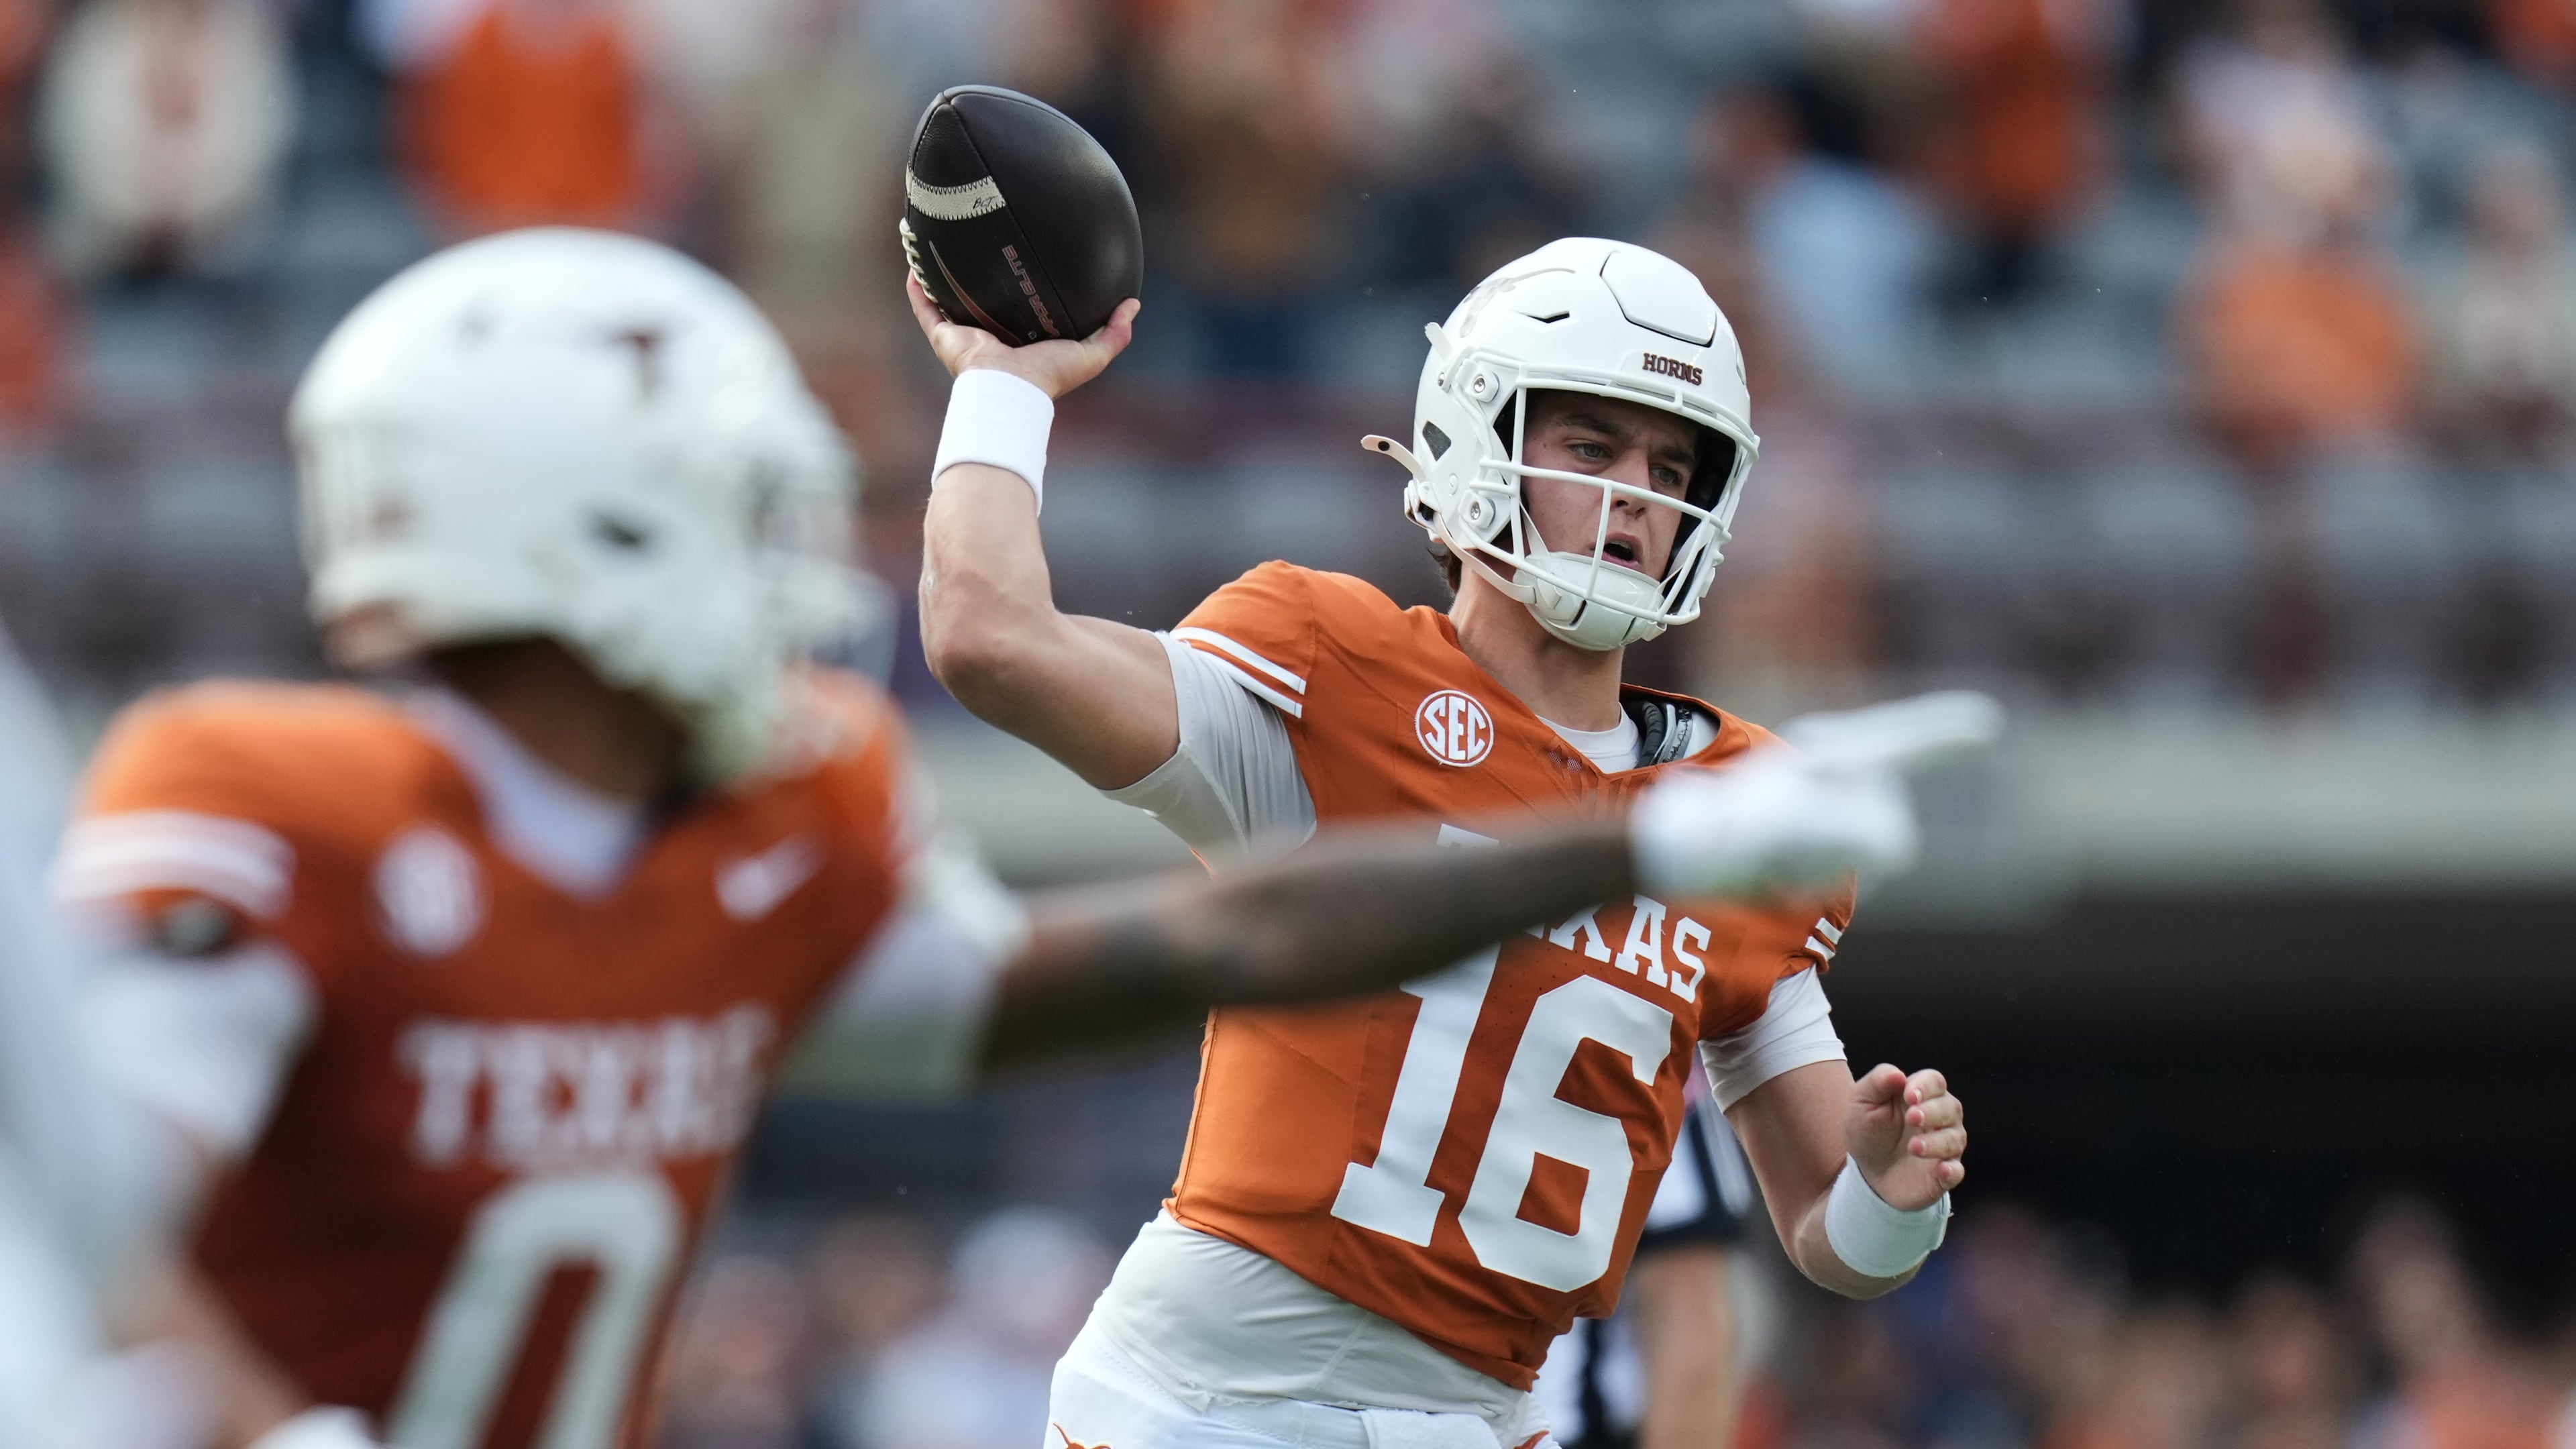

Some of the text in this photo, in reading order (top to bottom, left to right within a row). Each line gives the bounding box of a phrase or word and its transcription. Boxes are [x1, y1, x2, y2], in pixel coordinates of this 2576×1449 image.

[1002, 244, 1036, 296] ELITE
[1642, 352, 1703, 386] HORNS
[1424, 696, 1487, 761] SEC
[1436, 822, 1712, 1004] XAS
[1330, 939, 1674, 1293] 16
